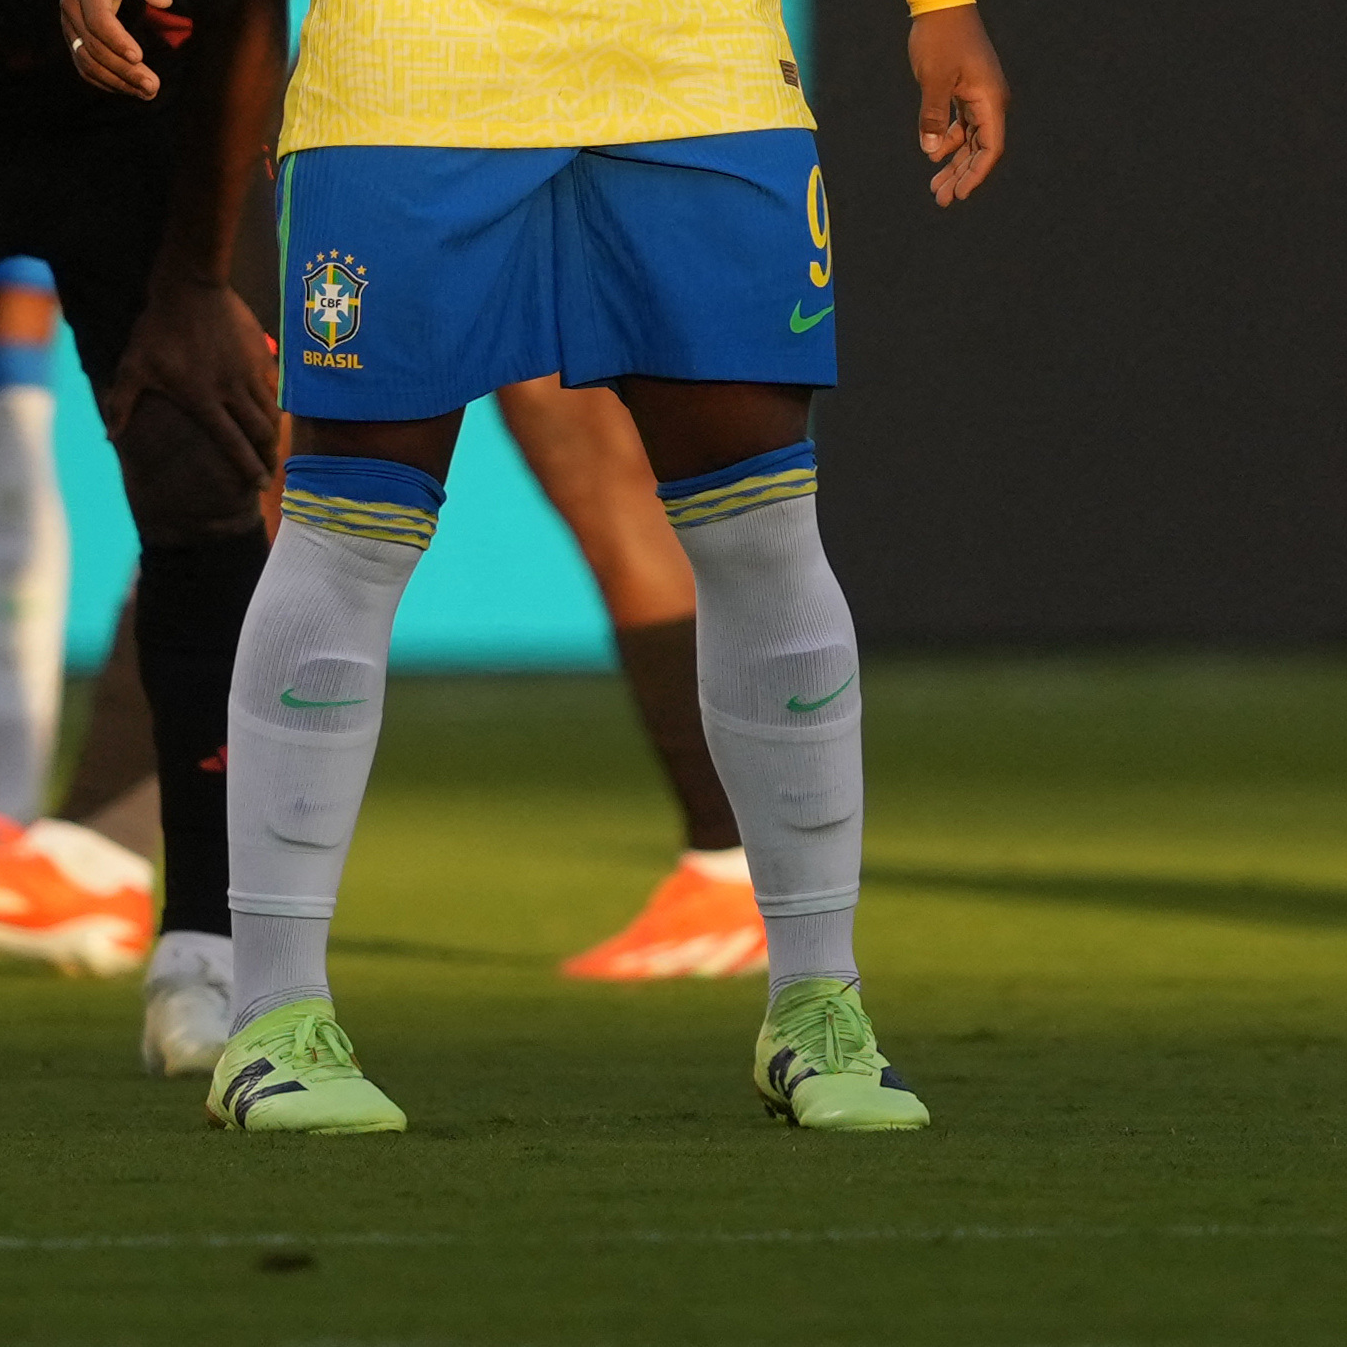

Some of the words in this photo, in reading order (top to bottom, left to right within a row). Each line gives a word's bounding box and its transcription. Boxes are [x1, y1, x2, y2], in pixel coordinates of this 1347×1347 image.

[807, 164, 832, 288] 9
[320, 298, 342, 308] CBF
[304, 350, 364, 369] BRASIL
